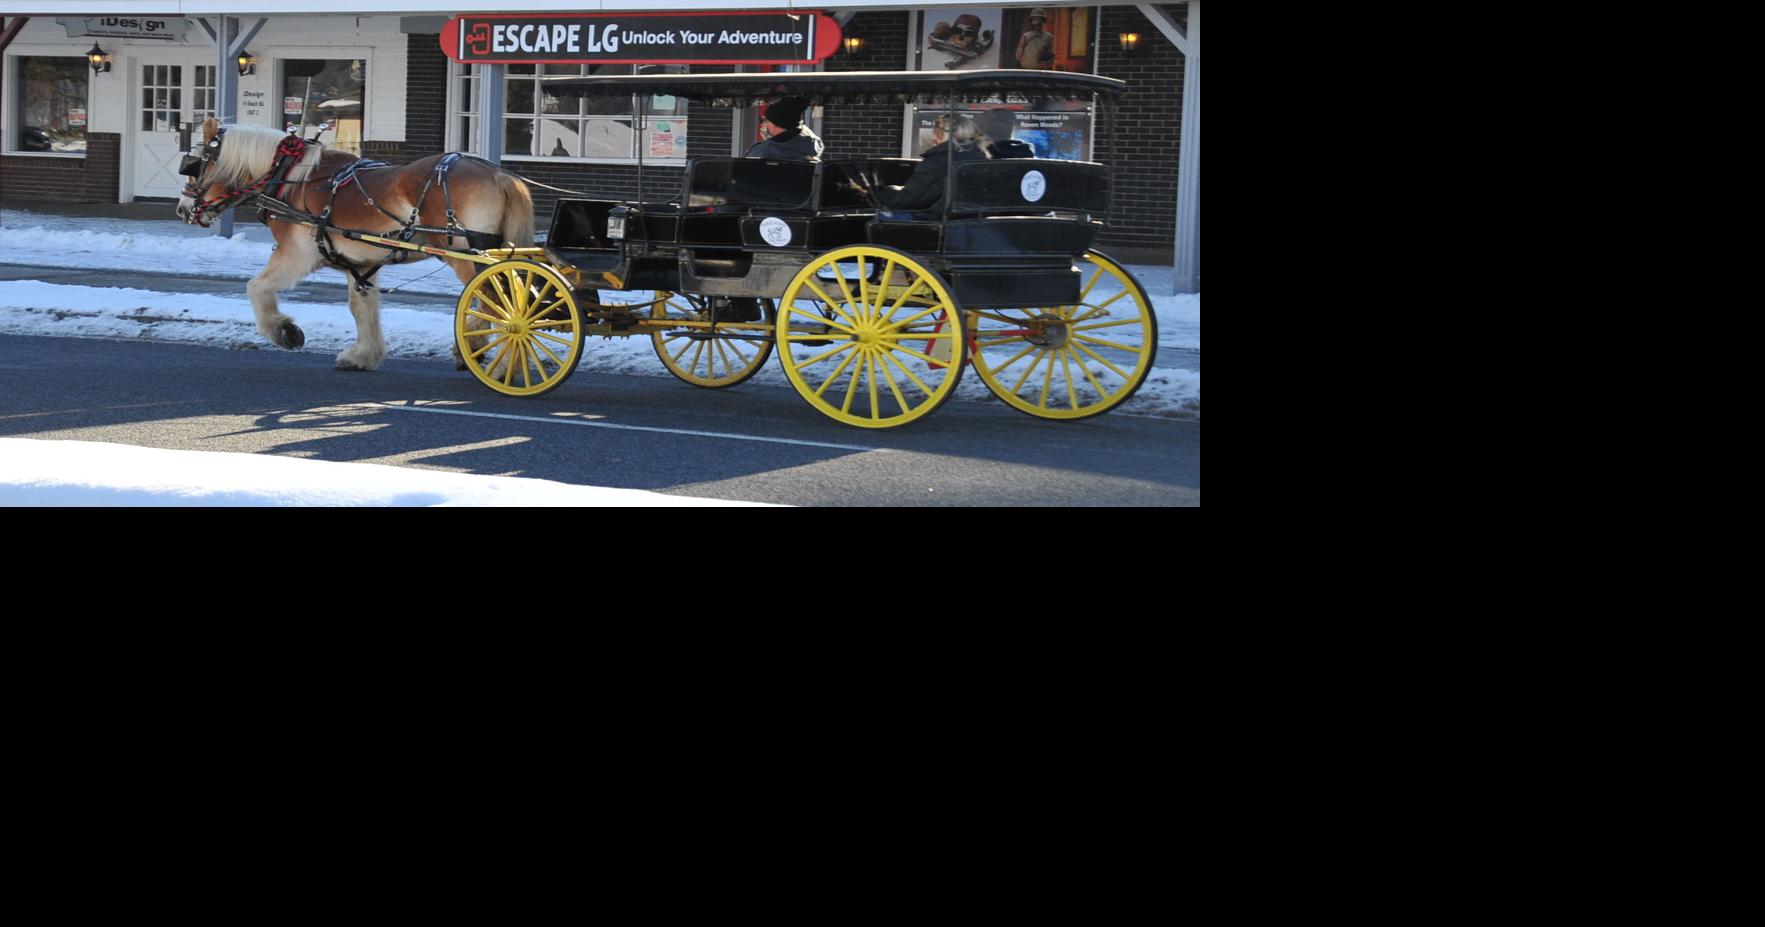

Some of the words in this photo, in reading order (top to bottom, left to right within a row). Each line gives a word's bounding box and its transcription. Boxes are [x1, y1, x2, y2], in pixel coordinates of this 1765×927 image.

[492, 24, 581, 53] ESCAPE
[587, 23, 619, 53] LG
[622, 30, 675, 45] Unlock
[679, 30, 715, 45] Your
[718, 30, 803, 45] Adventure
